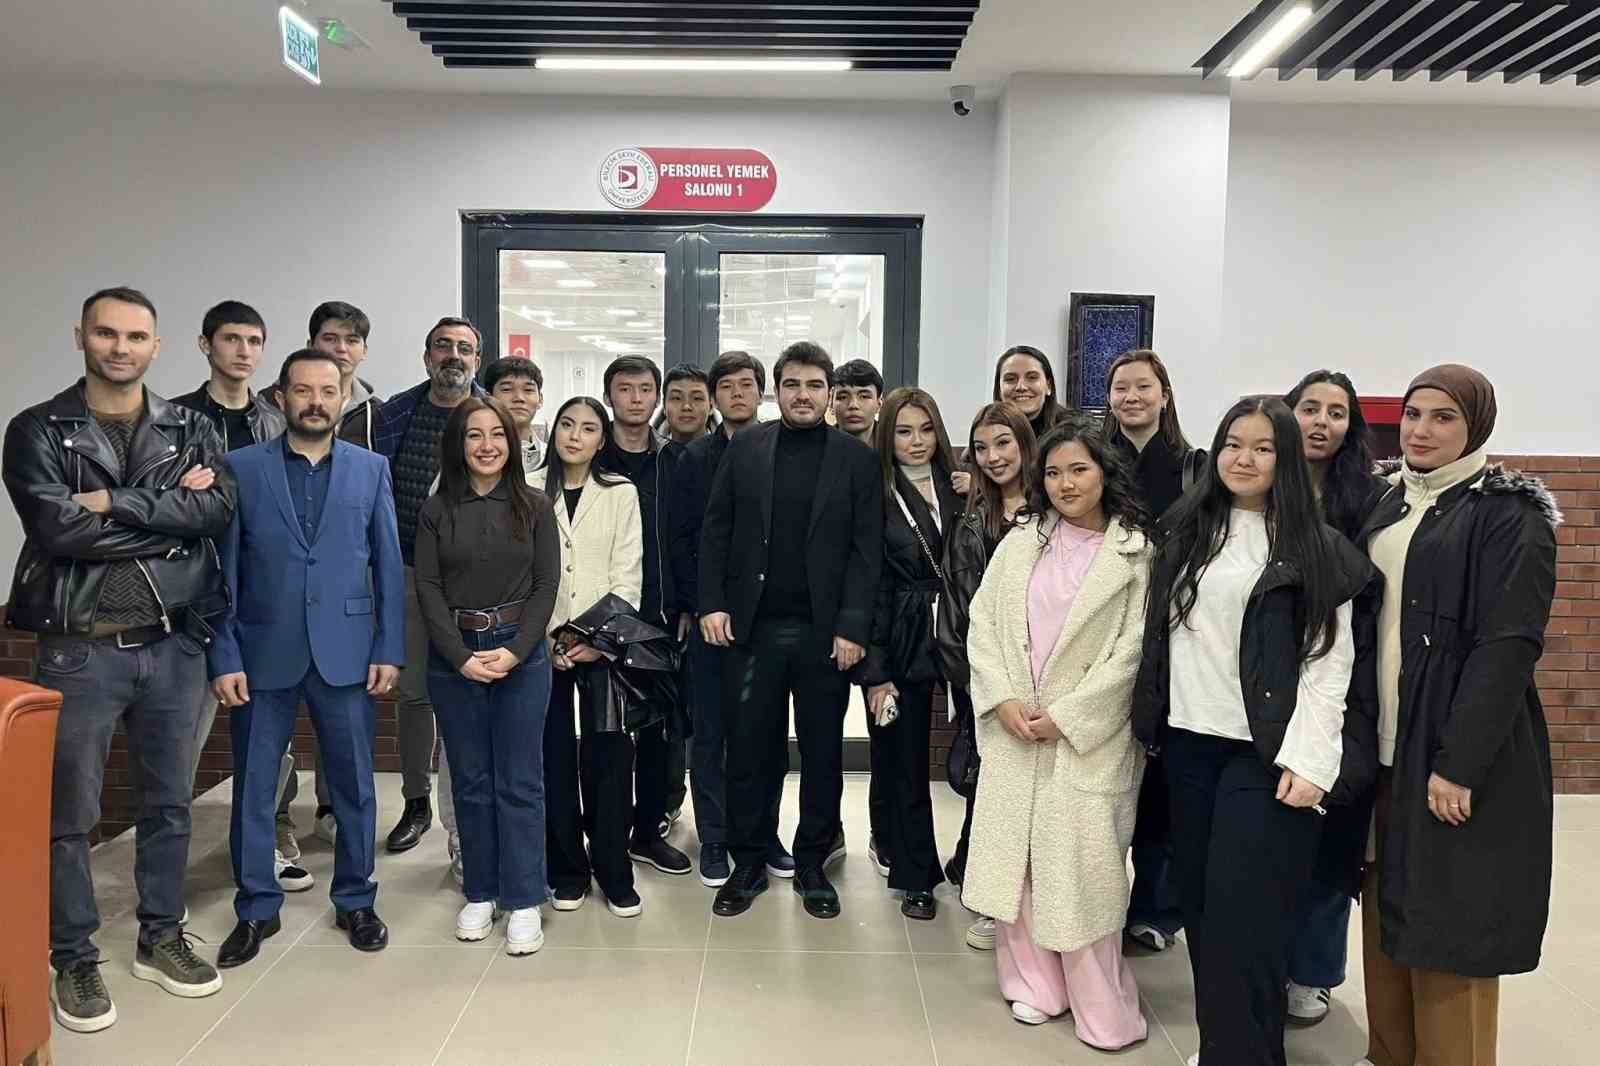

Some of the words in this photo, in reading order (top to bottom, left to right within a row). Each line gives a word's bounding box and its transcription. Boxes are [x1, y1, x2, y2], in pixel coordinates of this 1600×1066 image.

[660, 163, 723, 178] PERSONEL
[727, 164, 769, 179] YEMEK
[684, 183, 732, 197] SALONU
[736, 183, 743, 197] 1
